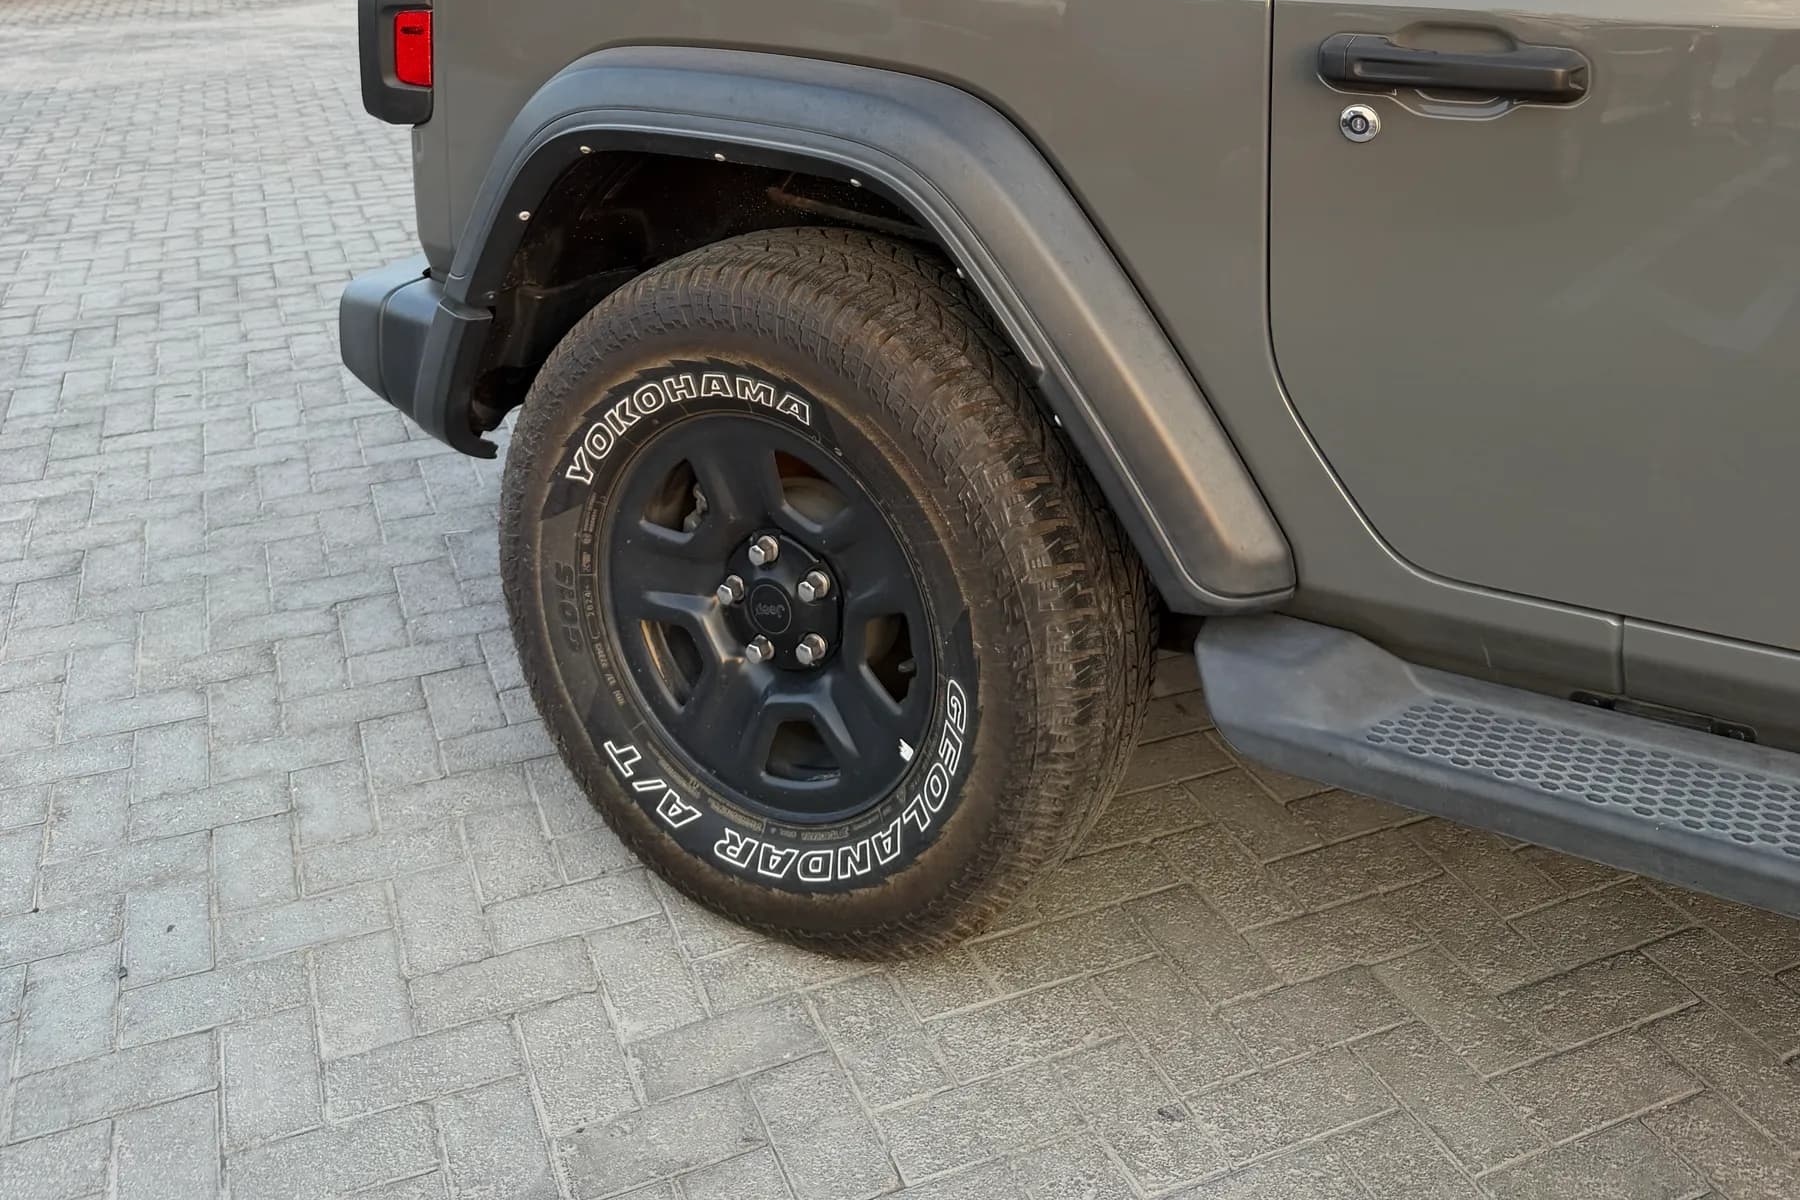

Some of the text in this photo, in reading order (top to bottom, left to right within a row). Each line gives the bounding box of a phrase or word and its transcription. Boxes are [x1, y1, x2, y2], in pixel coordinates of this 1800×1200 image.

[565, 373, 810, 485] YOKOHAMA
[603, 679, 967, 882] GEOLANDAR A/T
